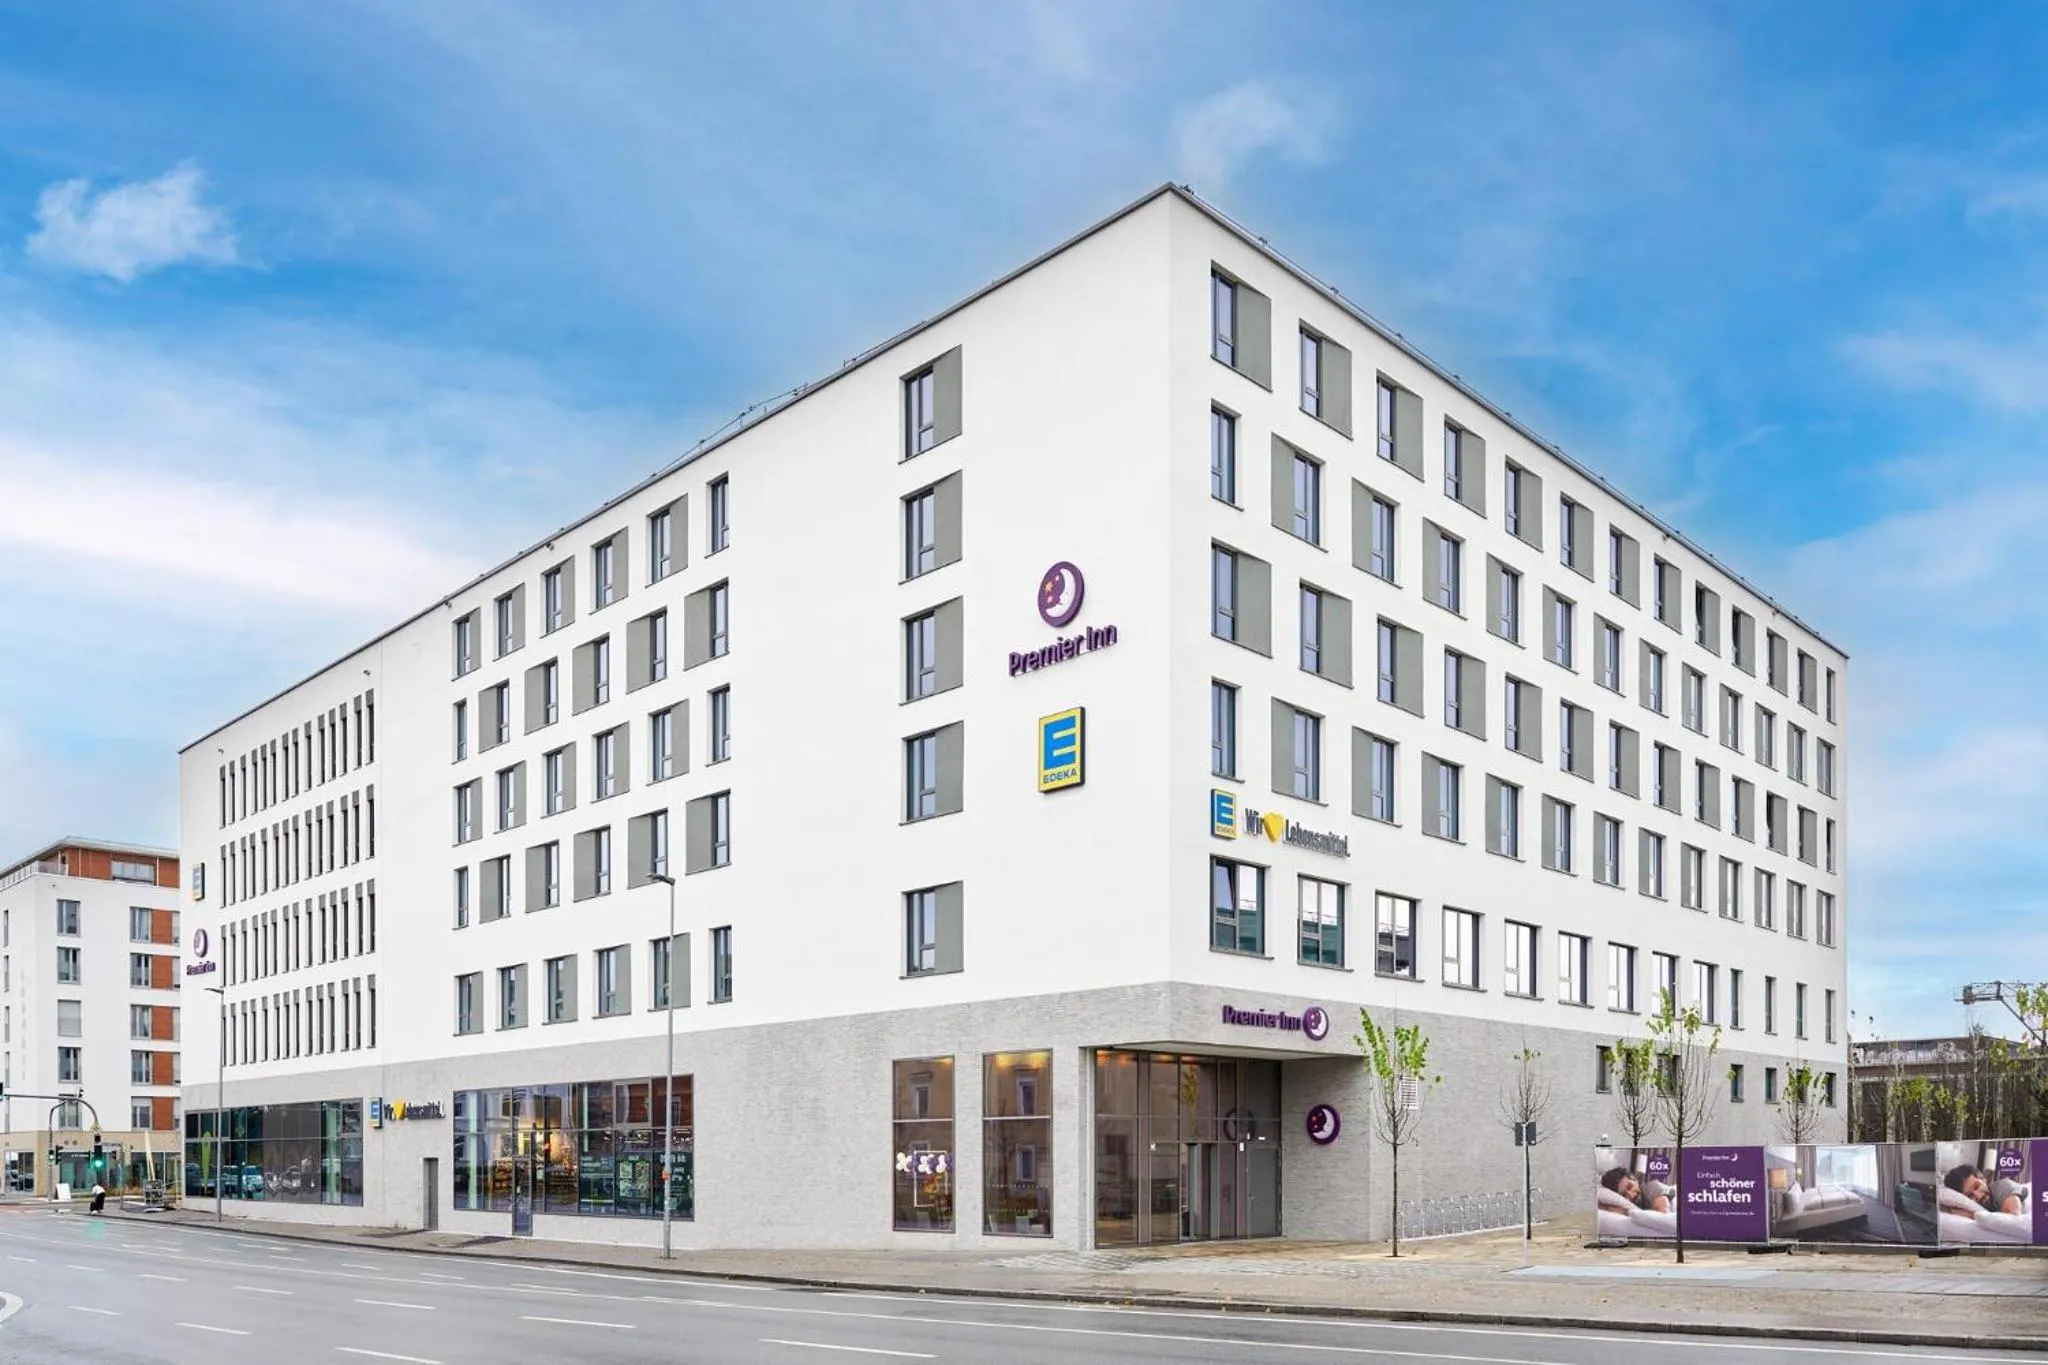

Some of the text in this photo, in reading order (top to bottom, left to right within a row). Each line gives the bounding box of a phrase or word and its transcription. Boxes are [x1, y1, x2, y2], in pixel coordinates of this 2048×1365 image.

[1009, 625, 1118, 677] Premier Inn
[1043, 715, 1077, 770] E
[1043, 768, 1078, 784] EDEKA
[1216, 794, 1234, 826] E
[1245, 807, 1264, 836] Wir
[1222, 1005, 1301, 1031] Premier Inn
[1649, 1161, 1669, 1170] 60x
[2000, 1156, 2021, 1166] 60x
[1710, 1178, 1755, 1188] schöner
[1688, 1190, 1751, 1202] schlafen
